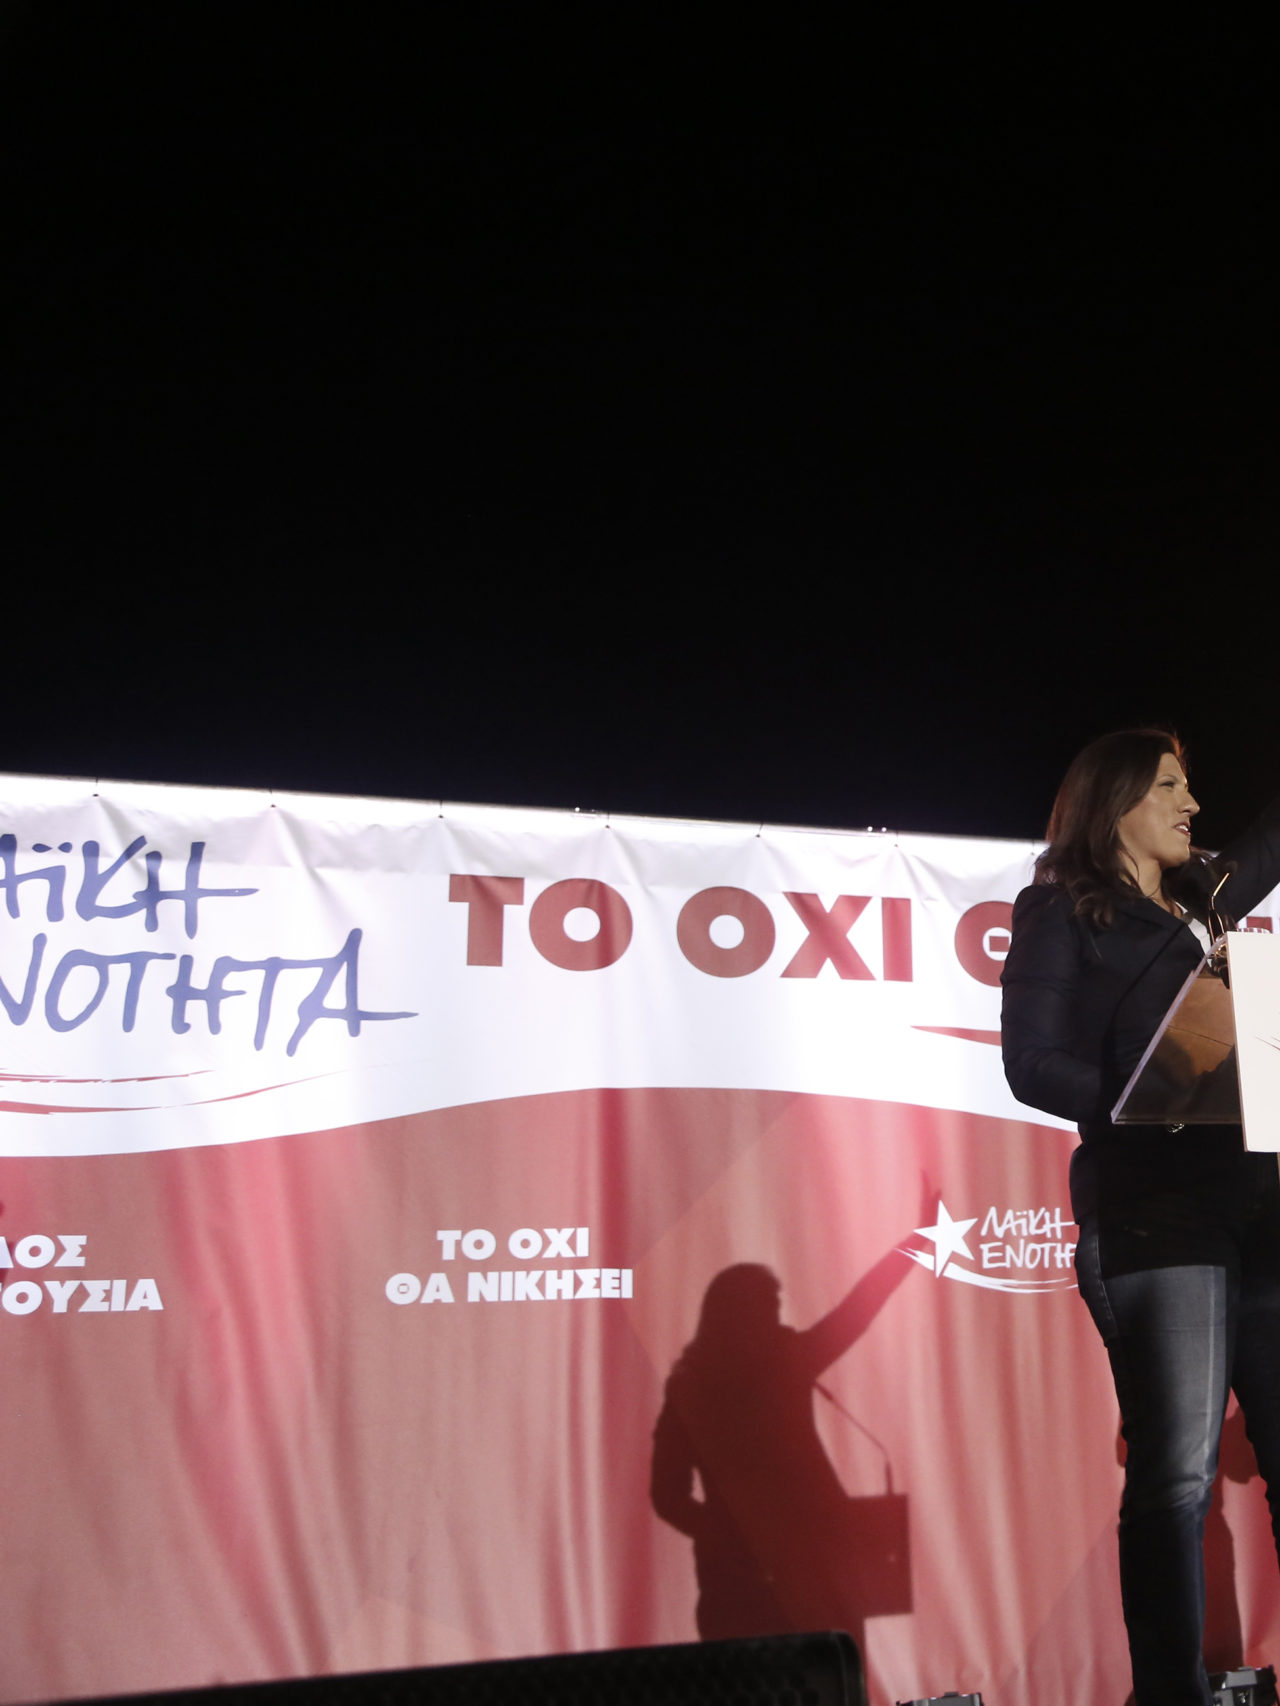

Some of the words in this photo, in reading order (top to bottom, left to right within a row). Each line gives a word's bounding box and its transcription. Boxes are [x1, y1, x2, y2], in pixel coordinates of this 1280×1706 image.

[449, 873, 633, 972] ΤΟ
[676, 886, 913, 982] ΟΧΙ
[954, 900, 1015, 988] Θ
[437, 1230, 496, 1260] ΤΟ
[508, 1227, 589, 1258] ΟΧΙ
[979, 1239, 1077, 1269] ΕΝΟΤΗ
[0, 1278, 164, 1315] ΟΥΣΙΑ
[385, 1272, 454, 1305] ΘΑ
[467, 1268, 633, 1302] ΝΙΚΗΣΕΙ
